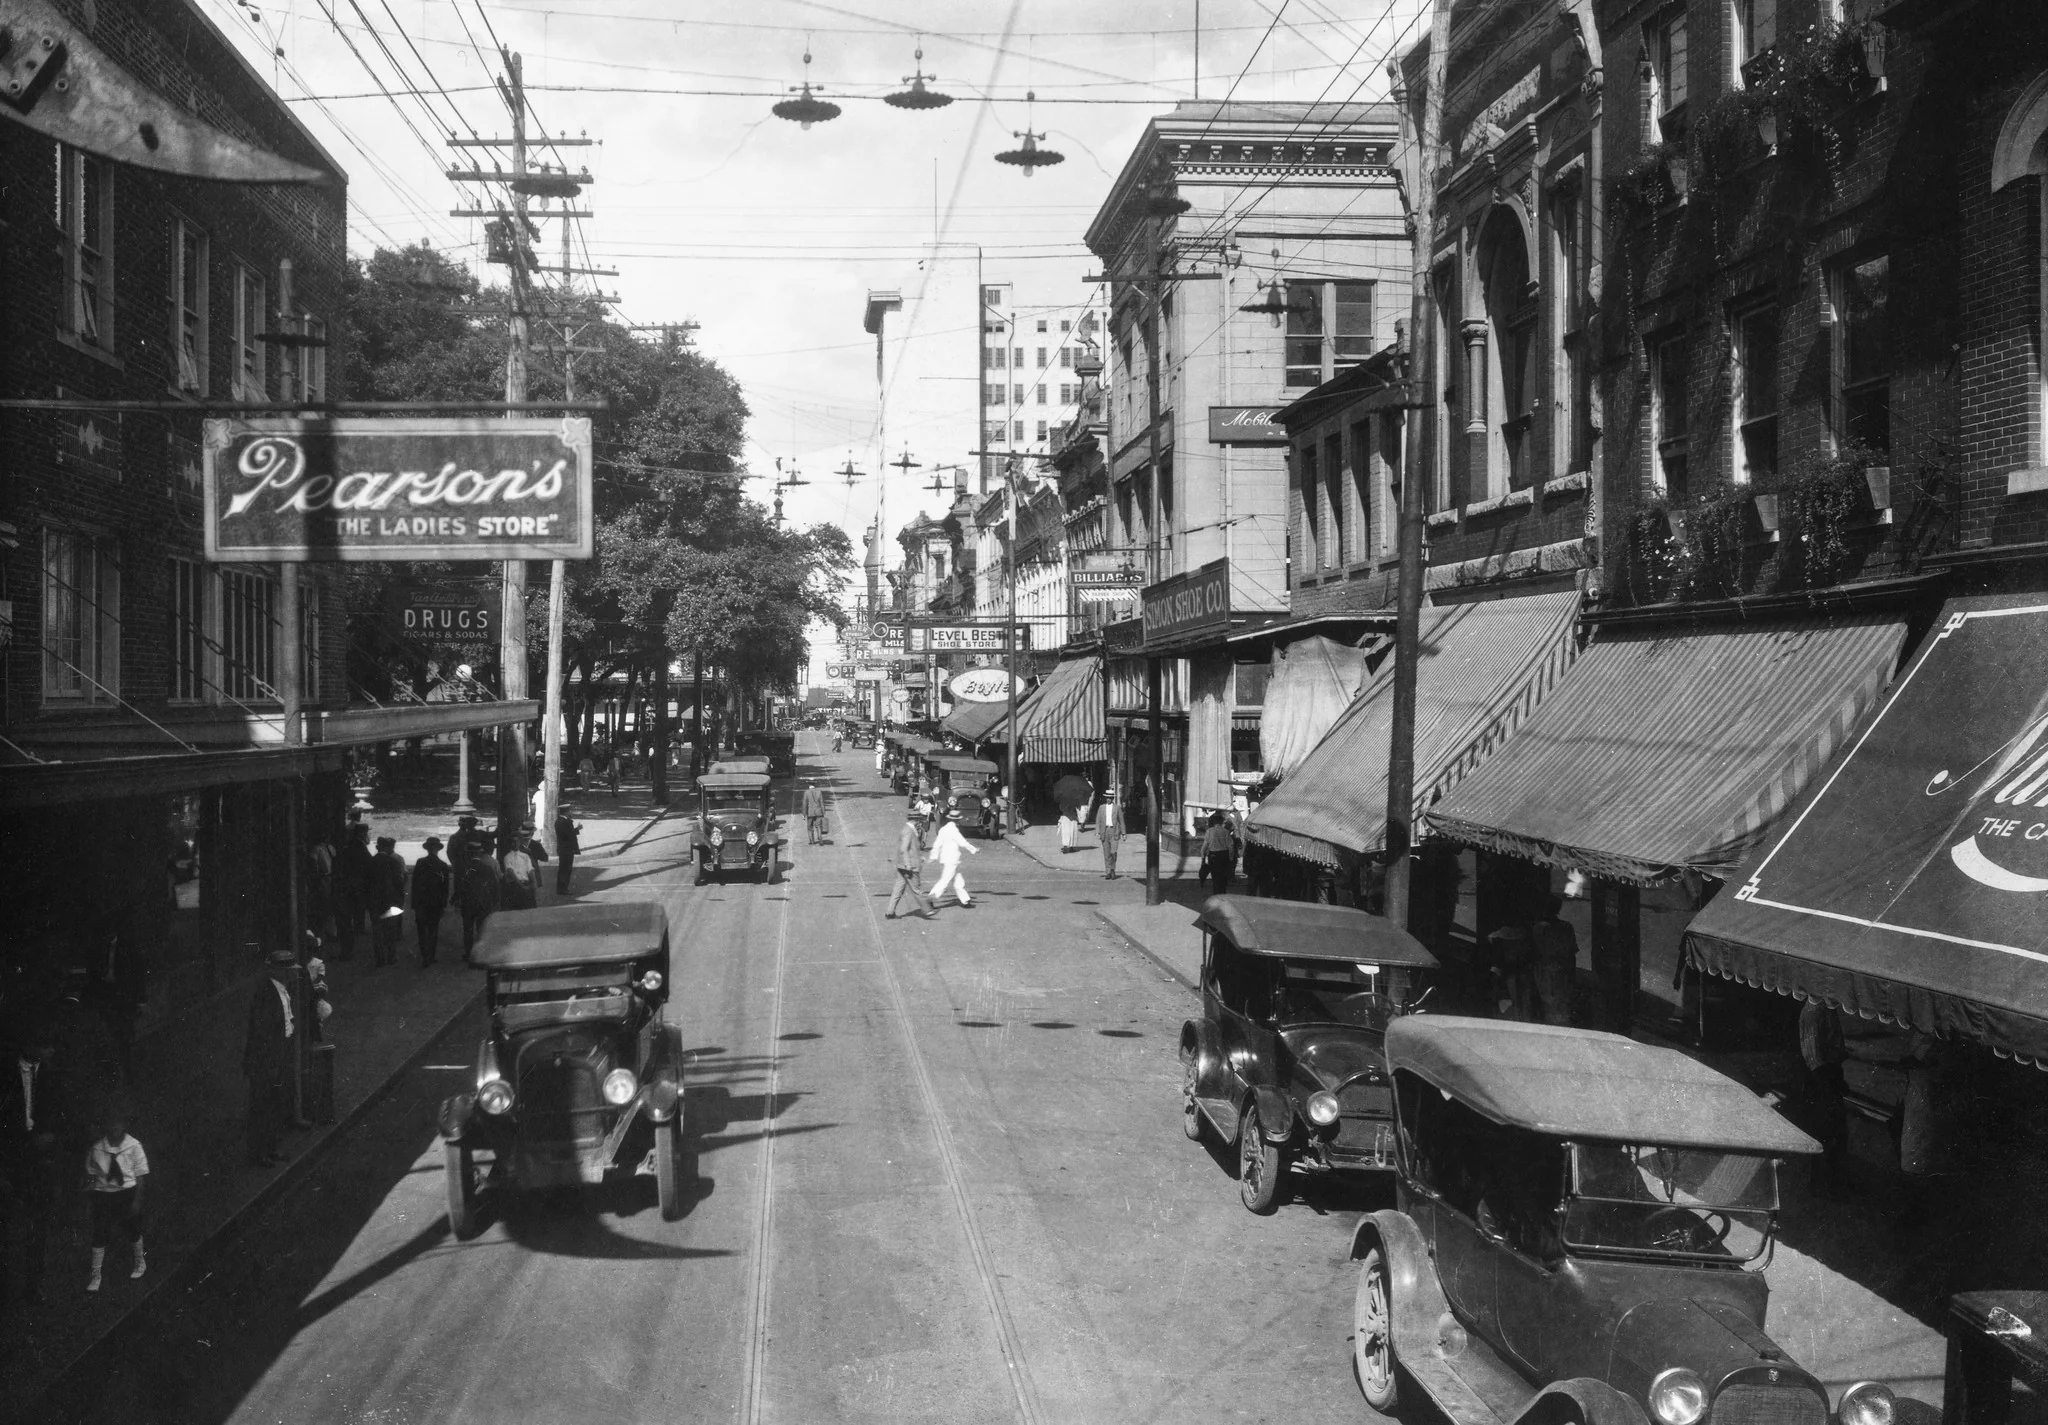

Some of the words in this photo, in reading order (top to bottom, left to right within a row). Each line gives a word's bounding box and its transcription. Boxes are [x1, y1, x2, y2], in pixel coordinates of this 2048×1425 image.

[219, 437, 567, 520] Pearson's
[380, 517, 467, 537] LADIES
[404, 609, 488, 628] DRUGS
[1146, 596, 1175, 631] SIMON
[1175, 586, 1203, 622] SHOE
[444, 630, 453, 639] &
[455, 631, 489, 639] SODAS
[932, 629, 968, 640] LEVEL
[972, 629, 1004, 640] BEST
[1978, 816, 2022, 837] THE
